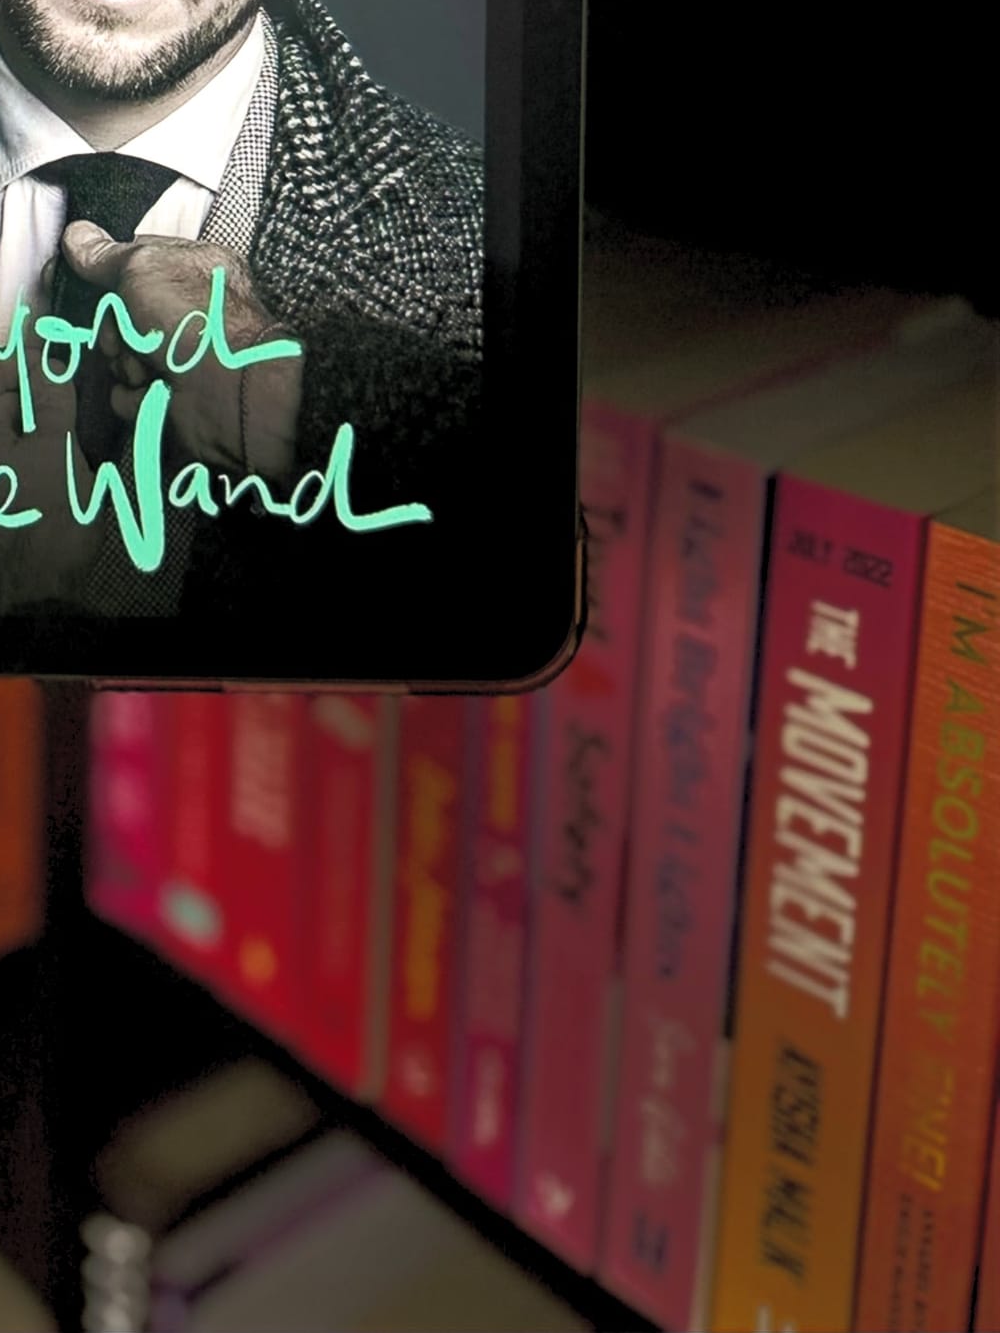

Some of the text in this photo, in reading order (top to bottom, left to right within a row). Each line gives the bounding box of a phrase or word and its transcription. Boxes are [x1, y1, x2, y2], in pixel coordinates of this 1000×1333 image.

[67, 379, 433, 573] Wand
[950, 580, 1000, 666] I'M
[766, 598, 875, 1021] THE MOVEMENT
[917, 677, 988, 1044] ABSOLUTELY
